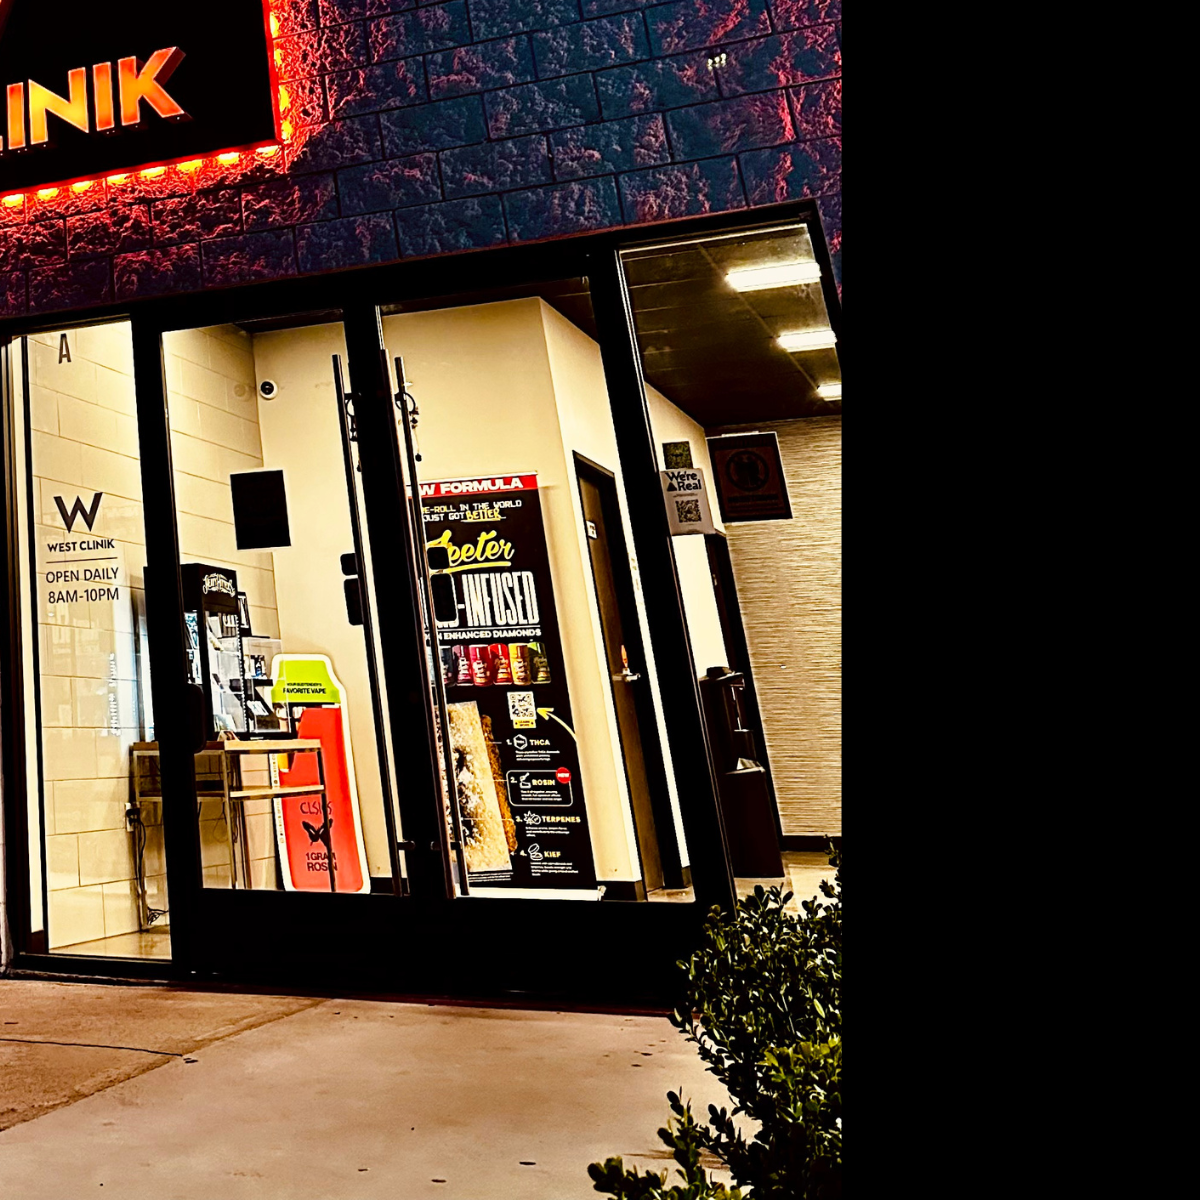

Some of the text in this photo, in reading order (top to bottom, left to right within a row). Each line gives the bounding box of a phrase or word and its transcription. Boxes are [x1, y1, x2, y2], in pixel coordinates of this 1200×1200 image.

[58, 333, 72, 364] A
[665, 470, 698, 482] We're
[440, 477, 523, 495] FORMULA
[677, 479, 702, 491] Real
[459, 503, 469, 511] IN
[472, 502, 490, 511] THE
[493, 500, 522, 509] WORLD
[53, 492, 103, 534] W
[448, 511, 465, 520] GOT
[466, 508, 502, 521] BETTER
[47, 538, 115, 552] WEST CLINIK
[45, 567, 119, 584] OPEN DAILY
[48, 587, 119, 604] 8AM-10PM
[443, 631, 492, 640] ENHANCED
[493, 628, 541, 638] DIAMONDS
[283, 687, 326, 695] FAVORITE VAPE
[541, 815, 581, 823] TERPENES
[543, 850, 561, 858] KIEF
[306, 861, 339, 871] ROSN
